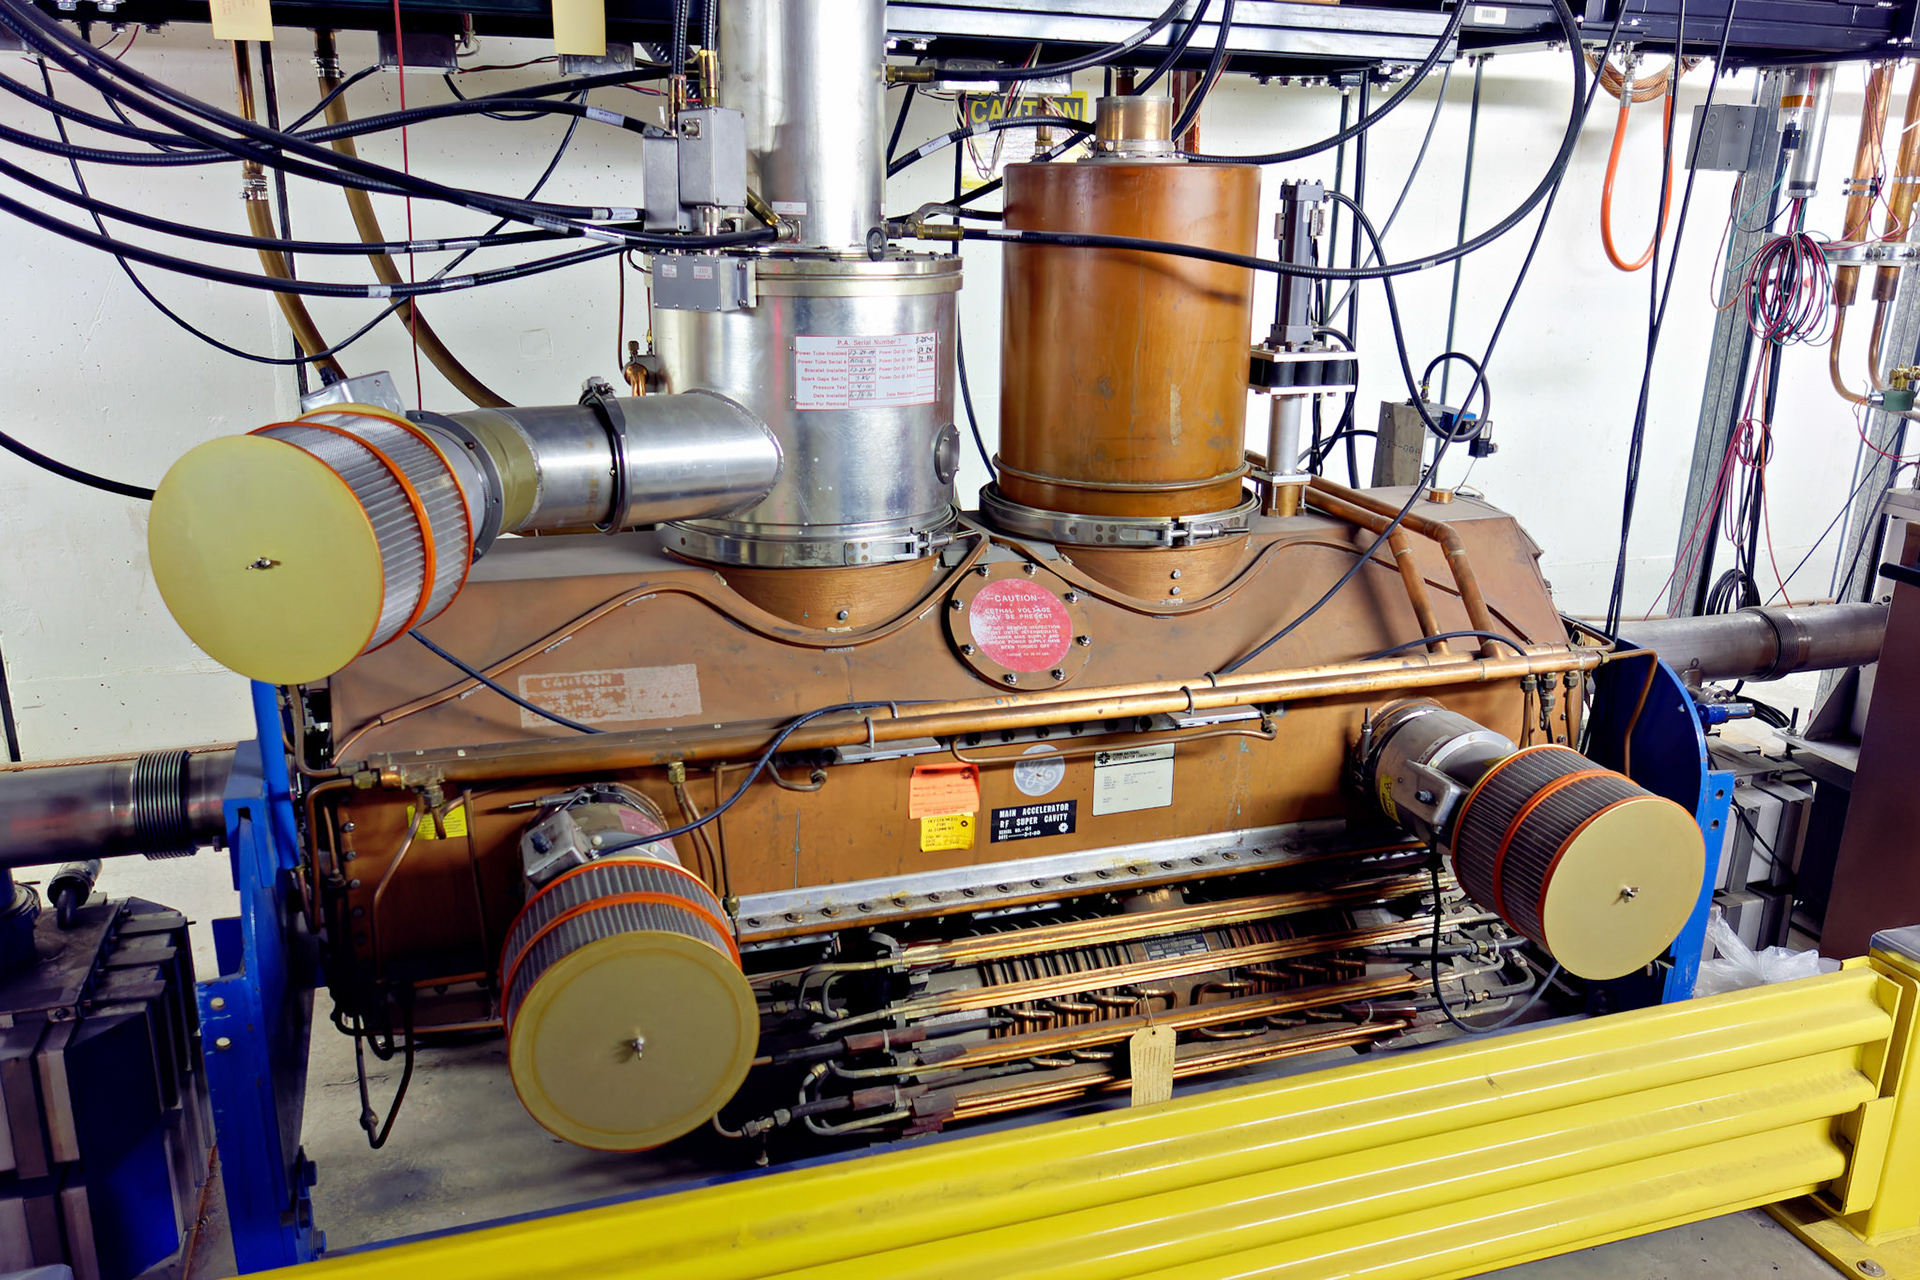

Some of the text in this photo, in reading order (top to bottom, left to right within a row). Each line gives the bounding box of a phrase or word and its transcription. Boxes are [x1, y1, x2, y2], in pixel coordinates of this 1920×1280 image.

[999, 803, 1069, 818] MAIN ACCELERATOR
[1000, 813, 1068, 828] RF SUPER CAVITY
